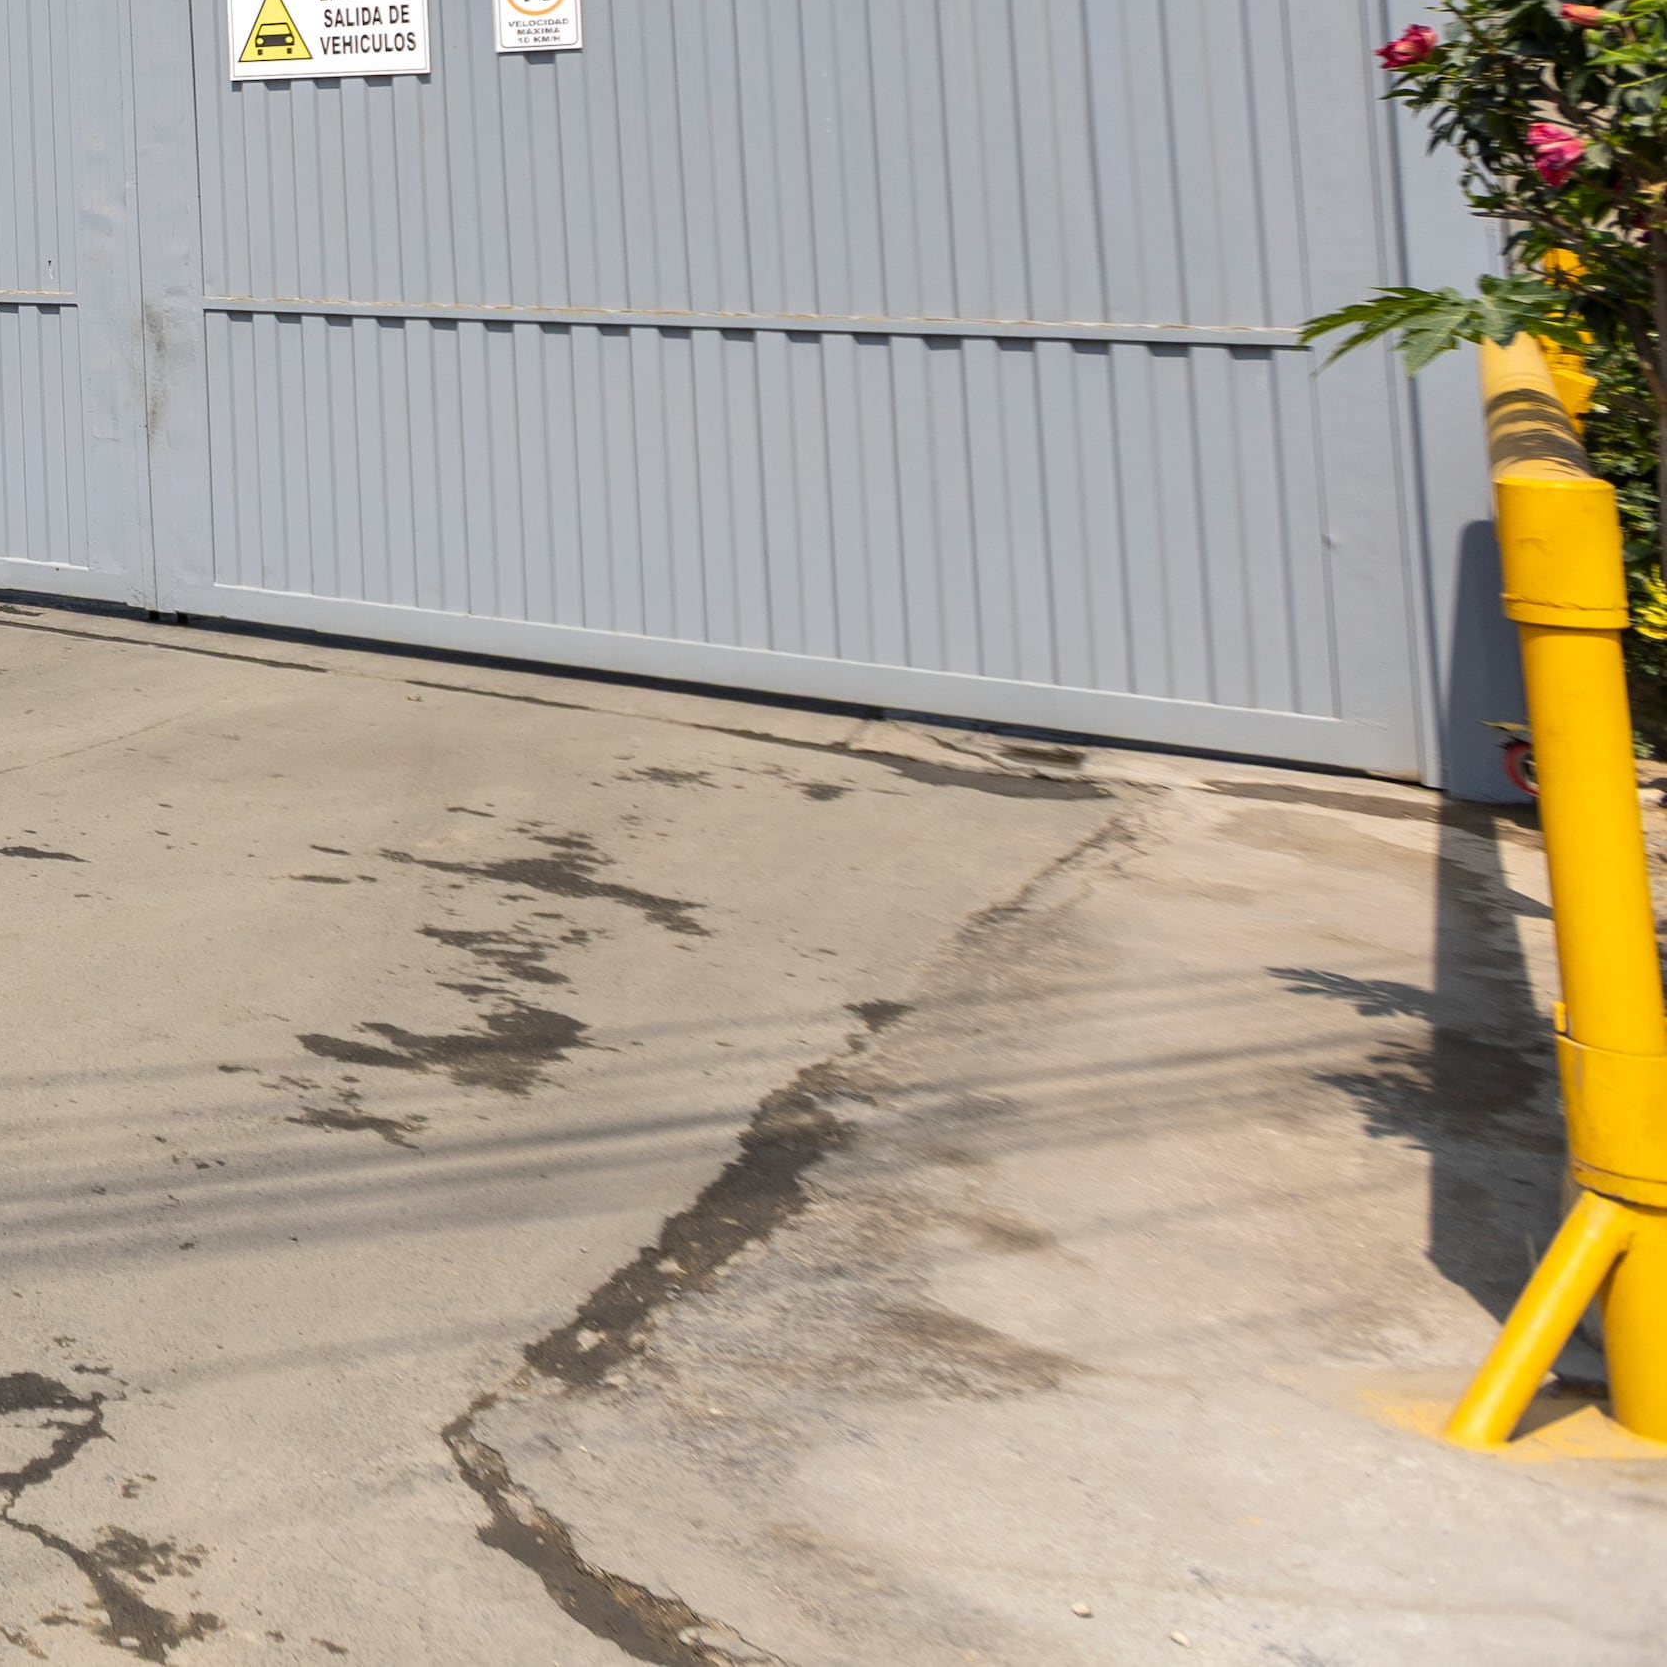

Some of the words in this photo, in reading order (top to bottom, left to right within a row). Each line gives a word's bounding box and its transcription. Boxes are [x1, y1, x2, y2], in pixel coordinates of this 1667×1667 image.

[324, 6, 383, 28] SALIDA
[389, 5, 411, 24] DE
[508, 18, 569, 27] VELOCIDAD
[320, 32, 416, 55] VEHICULOS
